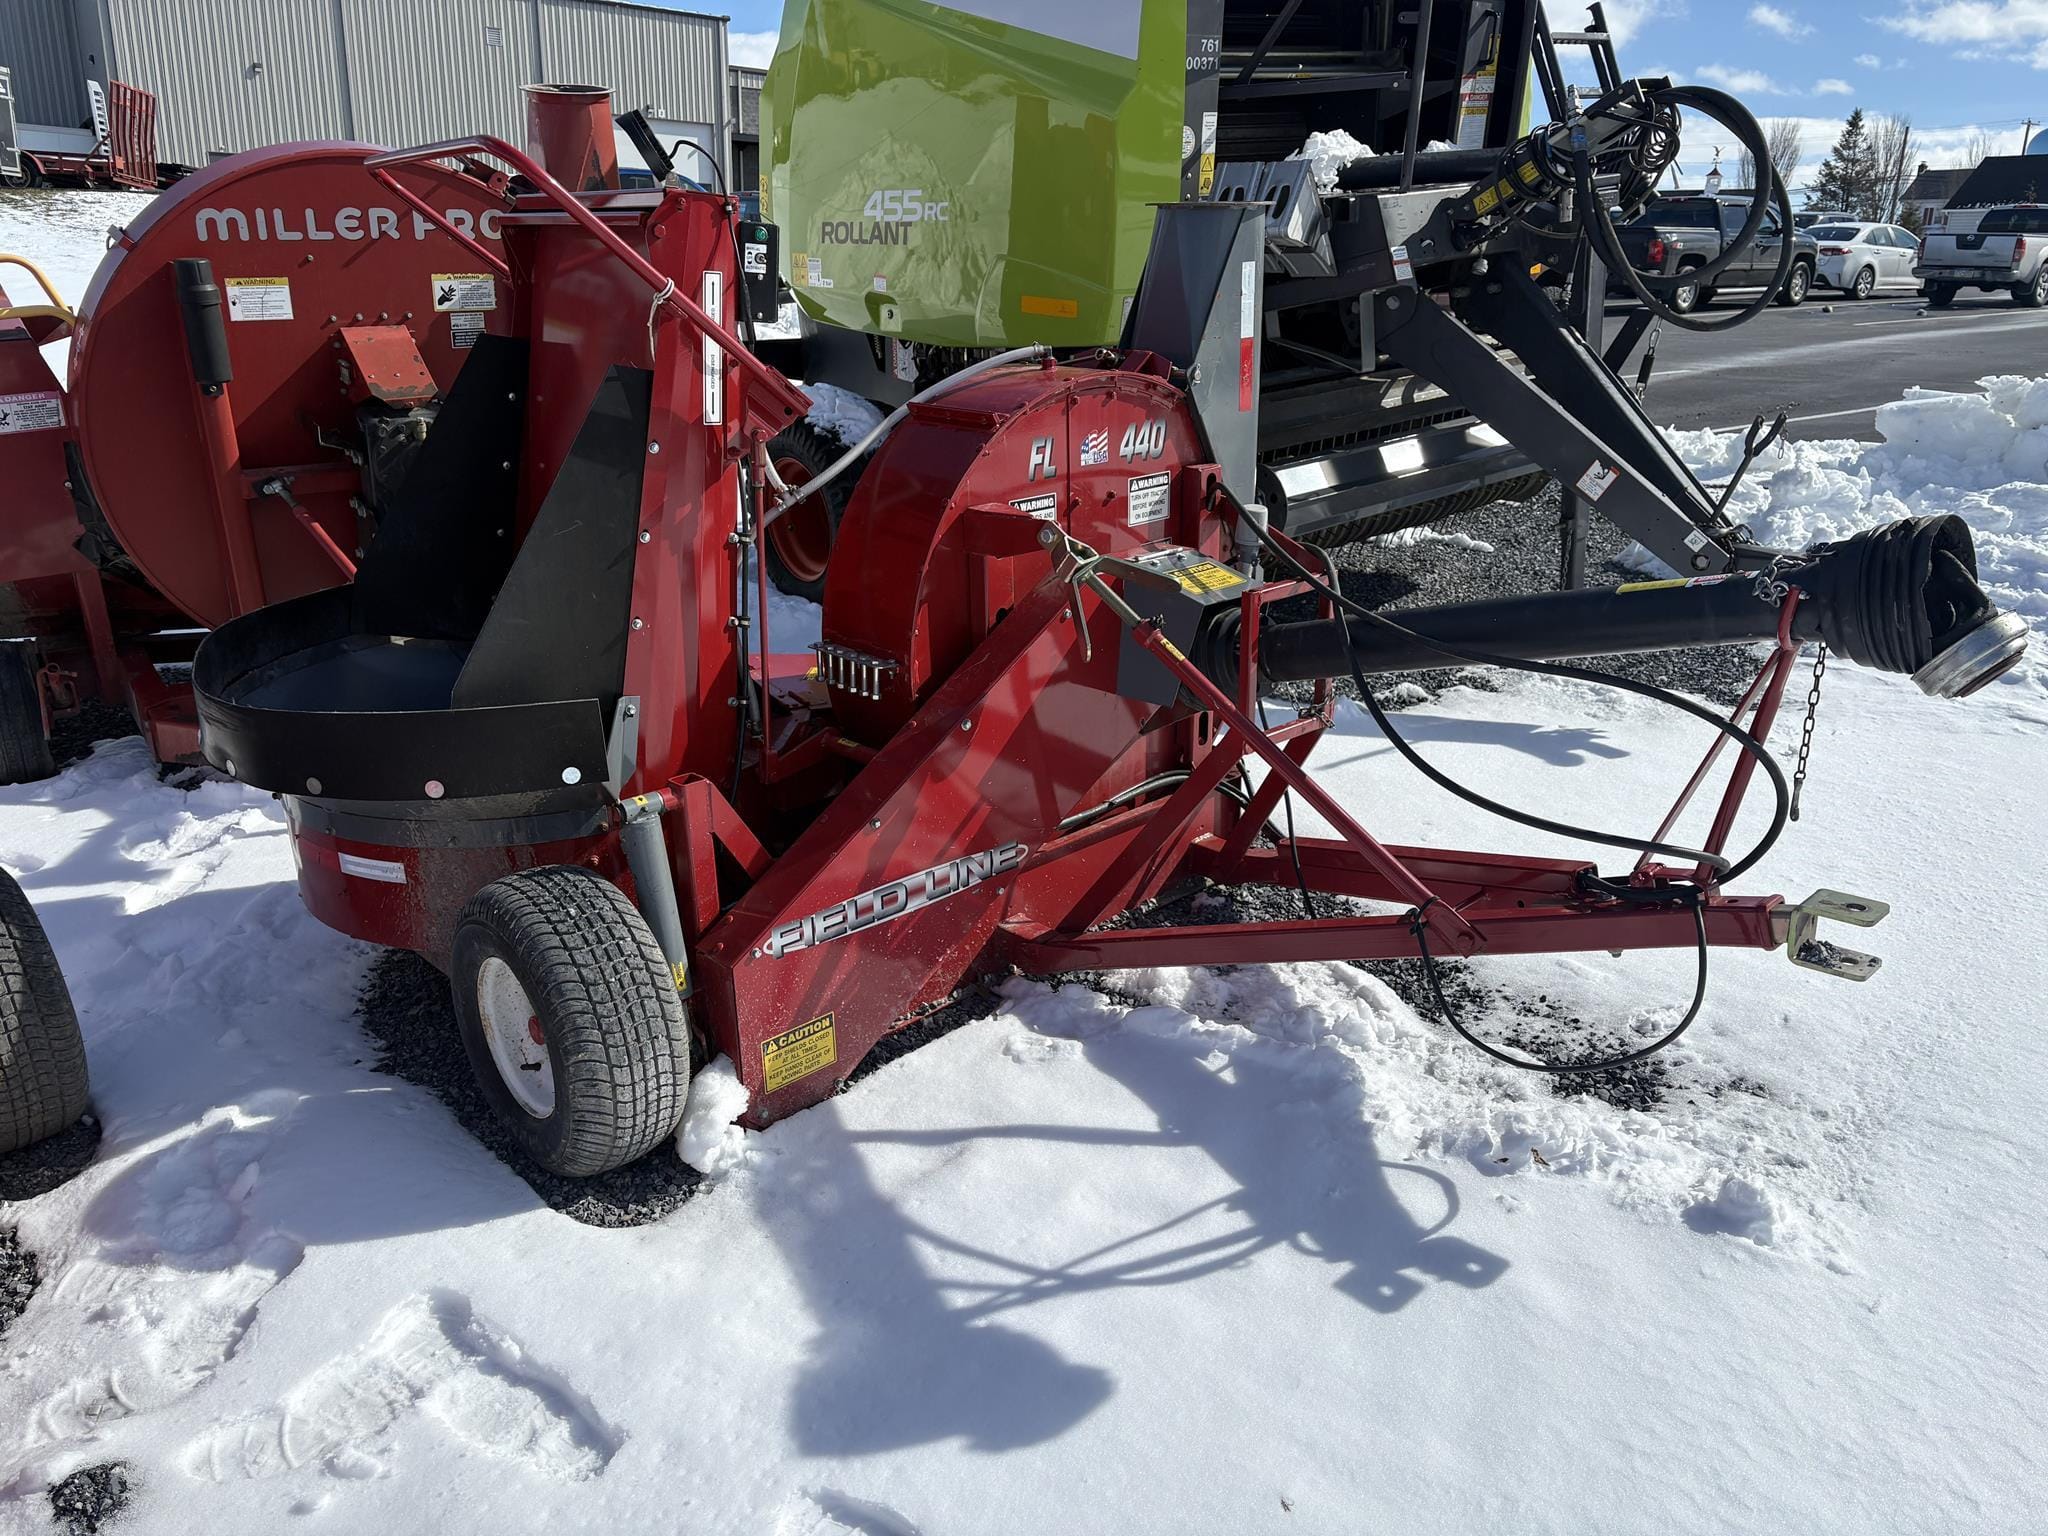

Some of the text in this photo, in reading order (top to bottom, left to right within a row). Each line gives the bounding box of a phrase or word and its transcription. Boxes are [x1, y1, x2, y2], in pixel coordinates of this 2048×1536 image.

[1201, 39, 1219, 52] 761
[1186, 56, 1219, 70] 00371
[195, 207, 401, 241] MILLER
[821, 221, 912, 245] ROLLANT
[1119, 418, 1167, 464] 440
[1028, 435, 1057, 481] FL
[1094, 450, 1108, 463] USA
[1138, 475, 1168, 489] WARNING
[1020, 497, 1054, 512] WARNING
[771, 840, 1019, 960] FIELD LINE
[779, 1018, 830, 1047] CAUTION
[768, 1031, 830, 1063] KEEP SHIELDS CLOSED
[782, 1044, 818, 1064] AT ALL TIMES
[768, 1048, 832, 1081] KEEP HANDS CLEAR OF
[782, 1060, 821, 1082] MOVING PARTS
